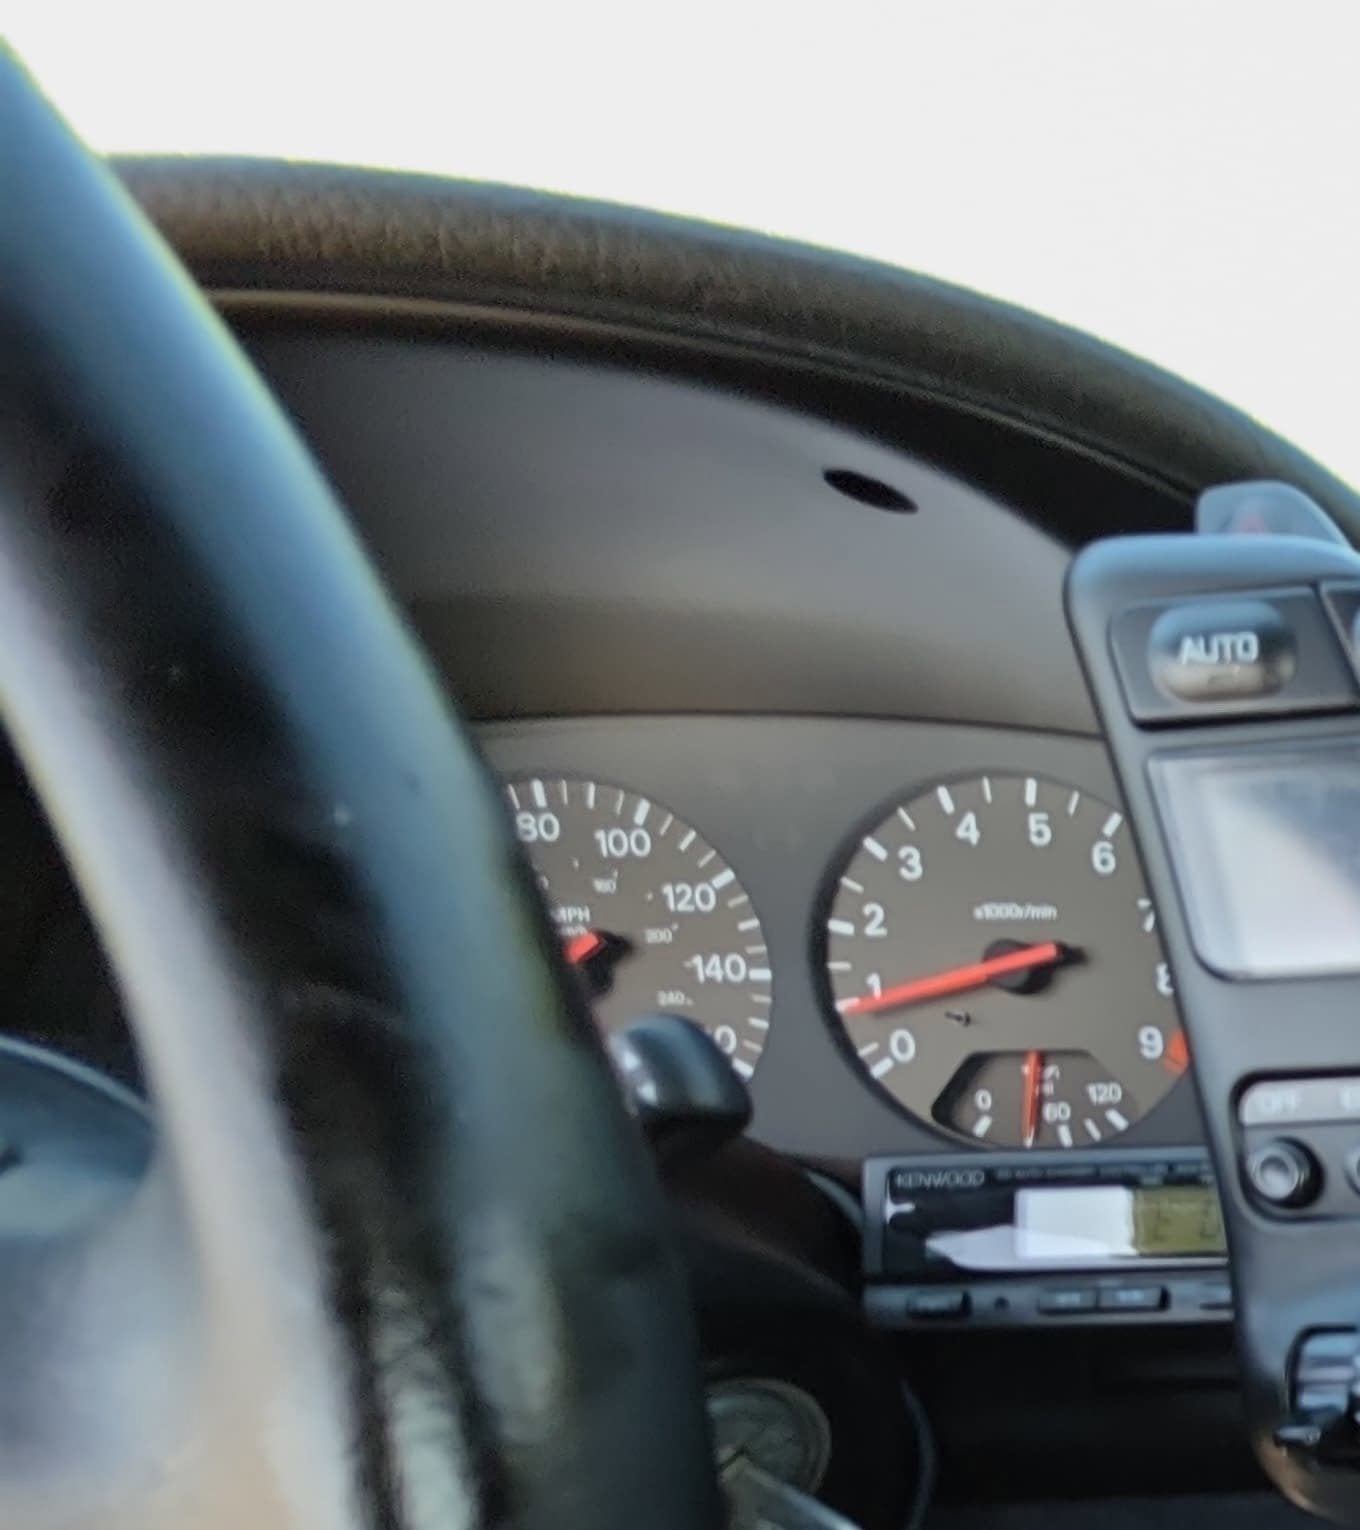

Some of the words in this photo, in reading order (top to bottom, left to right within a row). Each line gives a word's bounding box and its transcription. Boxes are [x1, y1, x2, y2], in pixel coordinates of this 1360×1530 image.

[1176, 632, 1258, 666] AUTO
[515, 811, 560, 841] 80
[956, 812, 980, 845] 4
[1029, 812, 1051, 846] 5
[594, 828, 651, 858] 100
[1092, 841, 1116, 875] 6
[899, 846, 923, 880] 3
[662, 883, 716, 912] 120
[863, 903, 888, 937] 2
[692, 954, 747, 983] 140
[866, 973, 884, 999] 1
[889, 1028, 916, 1063] 0
[1138, 1026, 1164, 1059] 9
[974, 1090, 993, 1112] 0
[1086, 1083, 1122, 1104] 120
[1043, 1103, 1071, 1126] 60
[895, 1169, 985, 1189] KENWOOD
